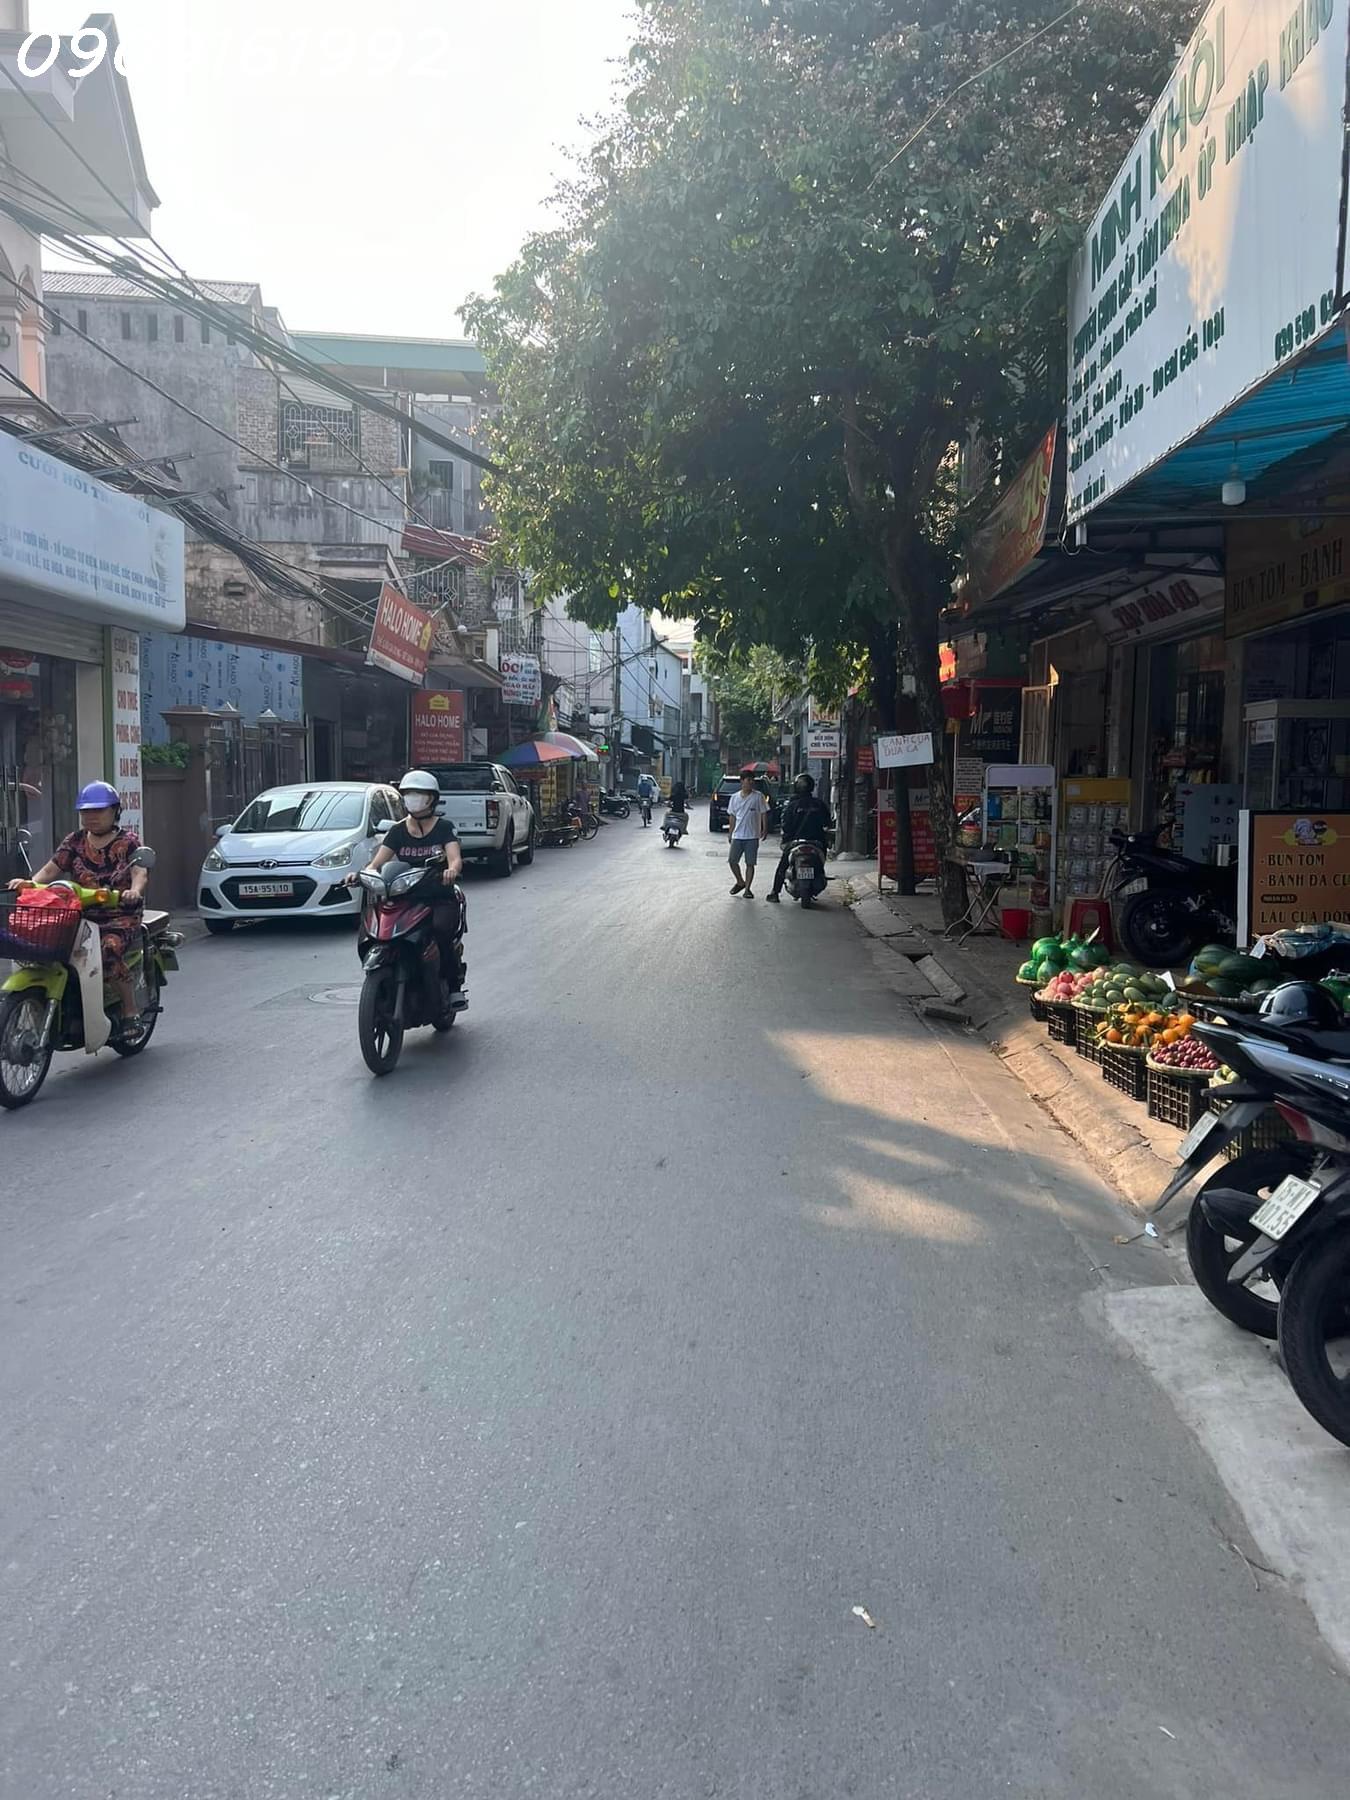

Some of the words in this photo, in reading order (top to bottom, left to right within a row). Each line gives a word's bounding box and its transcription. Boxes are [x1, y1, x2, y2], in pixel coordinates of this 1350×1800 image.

[1091, 154, 1142, 292] MINH
[1149, 6, 1225, 200] KHÔI
[1118, 244, 1136, 304] CẤP
[1136, 217, 1159, 284] TẤM
[1197, 125, 1217, 200] ỐP
[1225, 59, 1269, 166] NHẬP
[1203, 305, 1225, 352] loại
[380, 596, 403, 634] HALO
[400, 611, 423, 646] HOME
[415, 713, 437, 728] HALO
[437, 715, 461, 729] HOME
